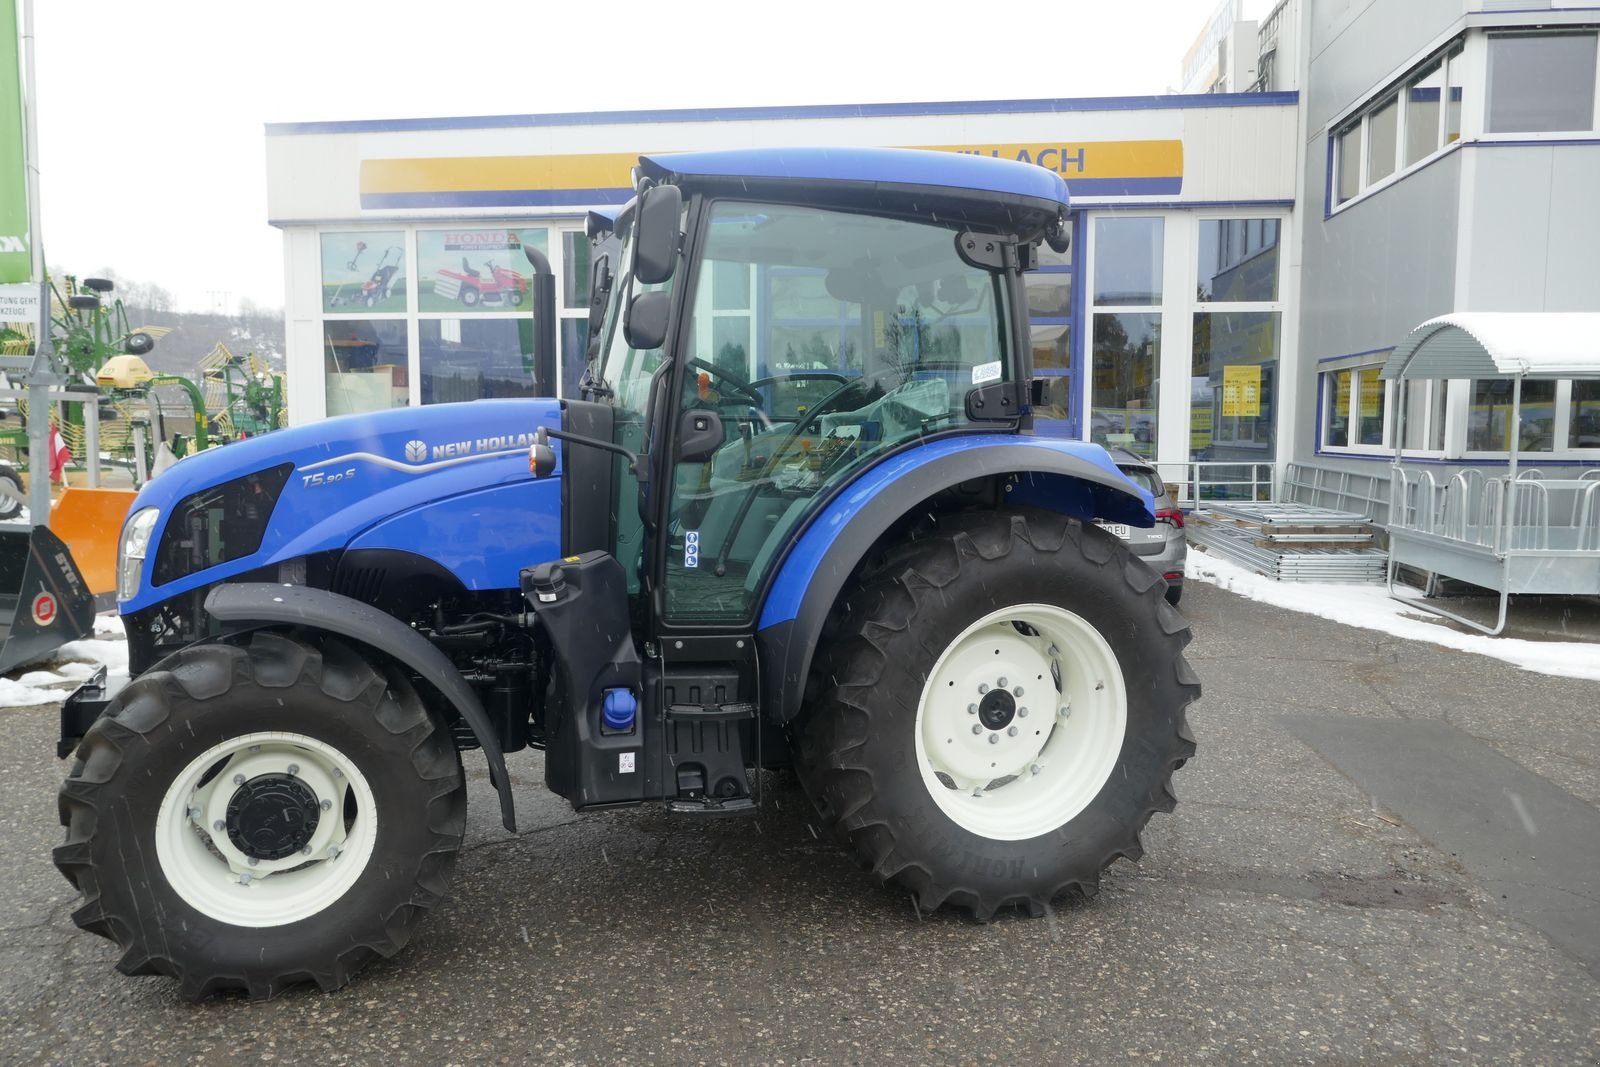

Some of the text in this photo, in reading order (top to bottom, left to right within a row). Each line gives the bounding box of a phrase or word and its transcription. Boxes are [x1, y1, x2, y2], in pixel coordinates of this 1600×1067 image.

[445, 233, 521, 243] HONDA
[432, 432, 551, 459] NEW HOLLAN
